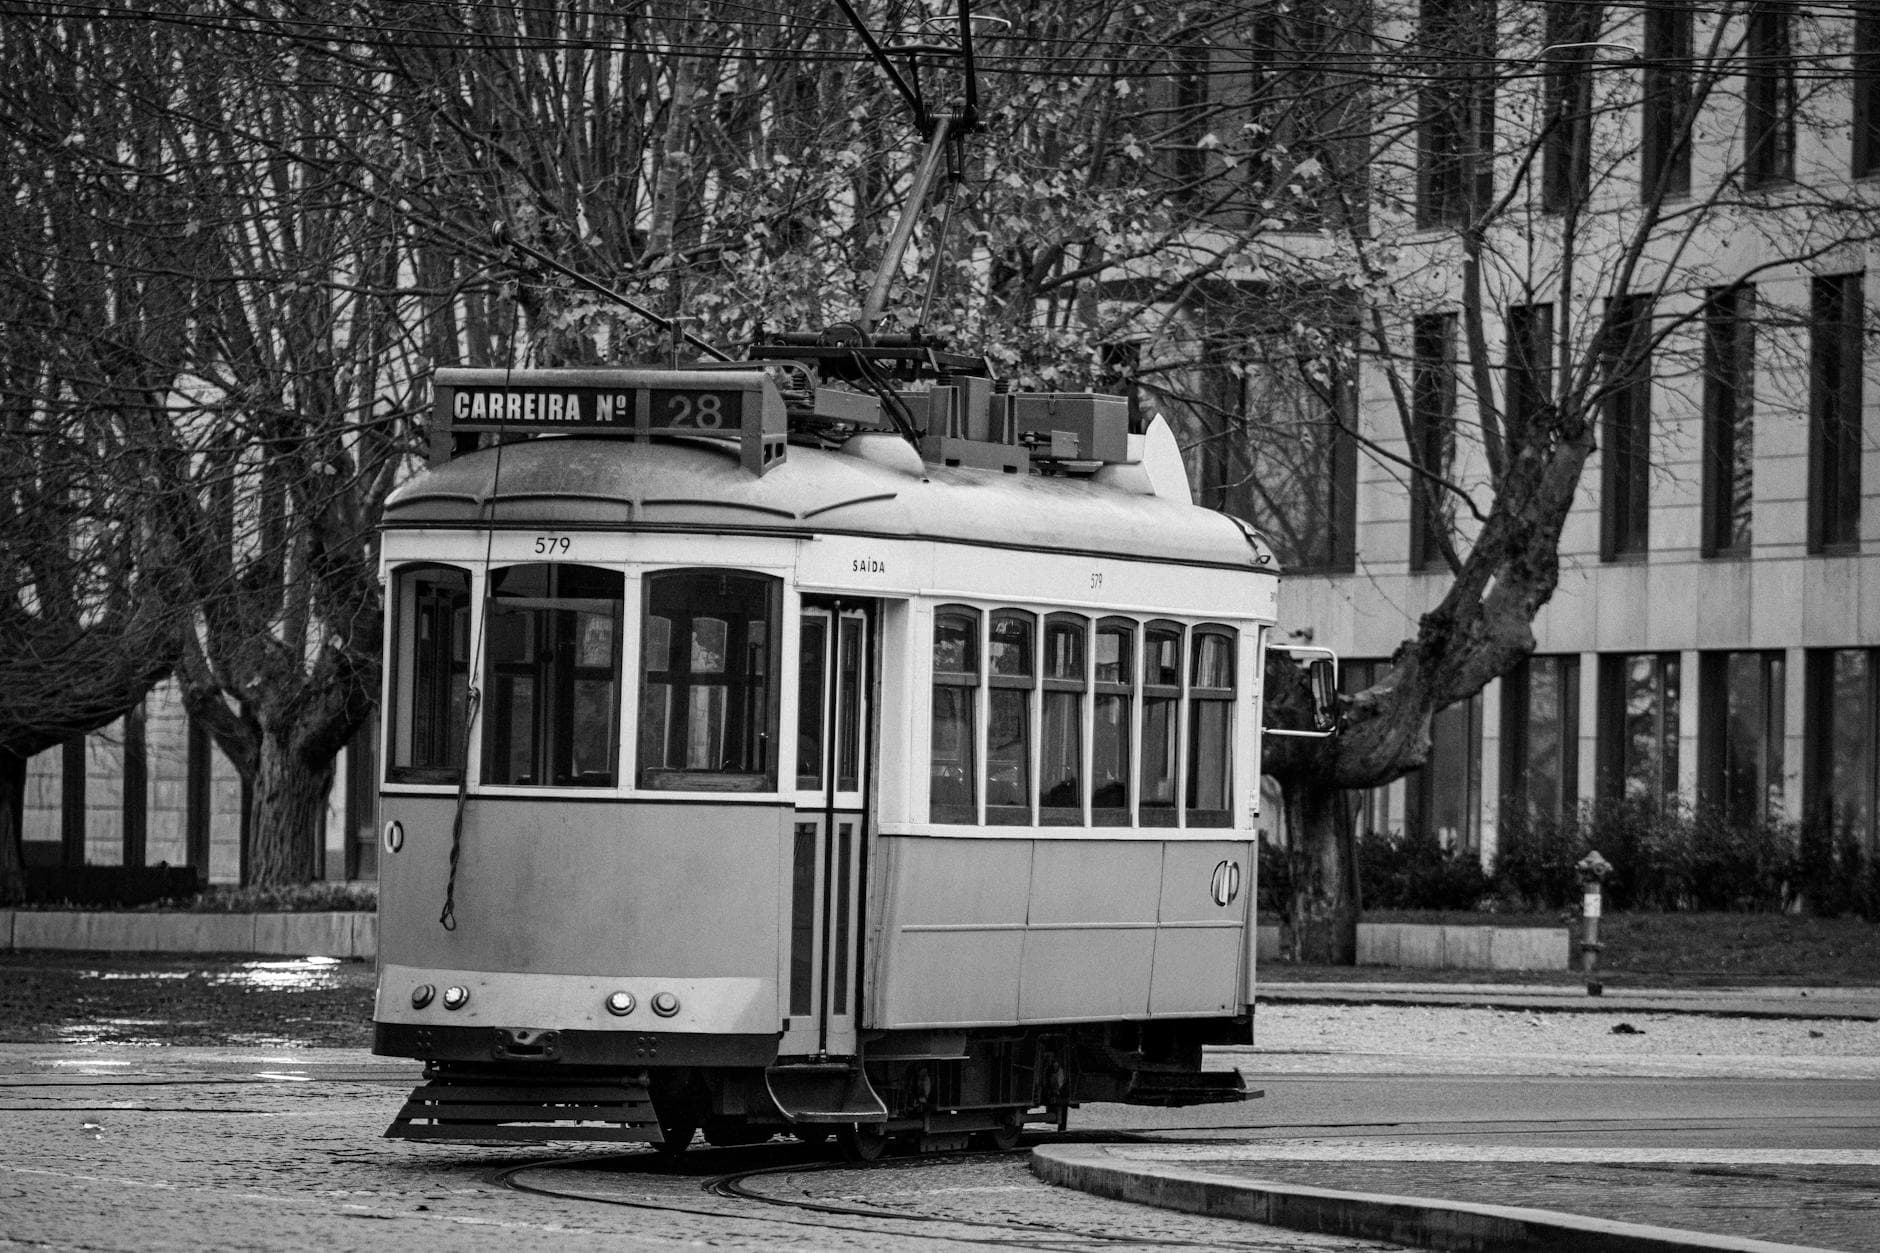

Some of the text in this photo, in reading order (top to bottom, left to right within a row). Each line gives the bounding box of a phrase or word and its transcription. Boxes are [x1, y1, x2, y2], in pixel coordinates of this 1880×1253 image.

[454, 391, 722, 429] CARREIRA Nº 28
[535, 537, 570, 554] 579
[852, 556, 885, 573] SAÍDA
[1090, 573, 1103, 589] 579
